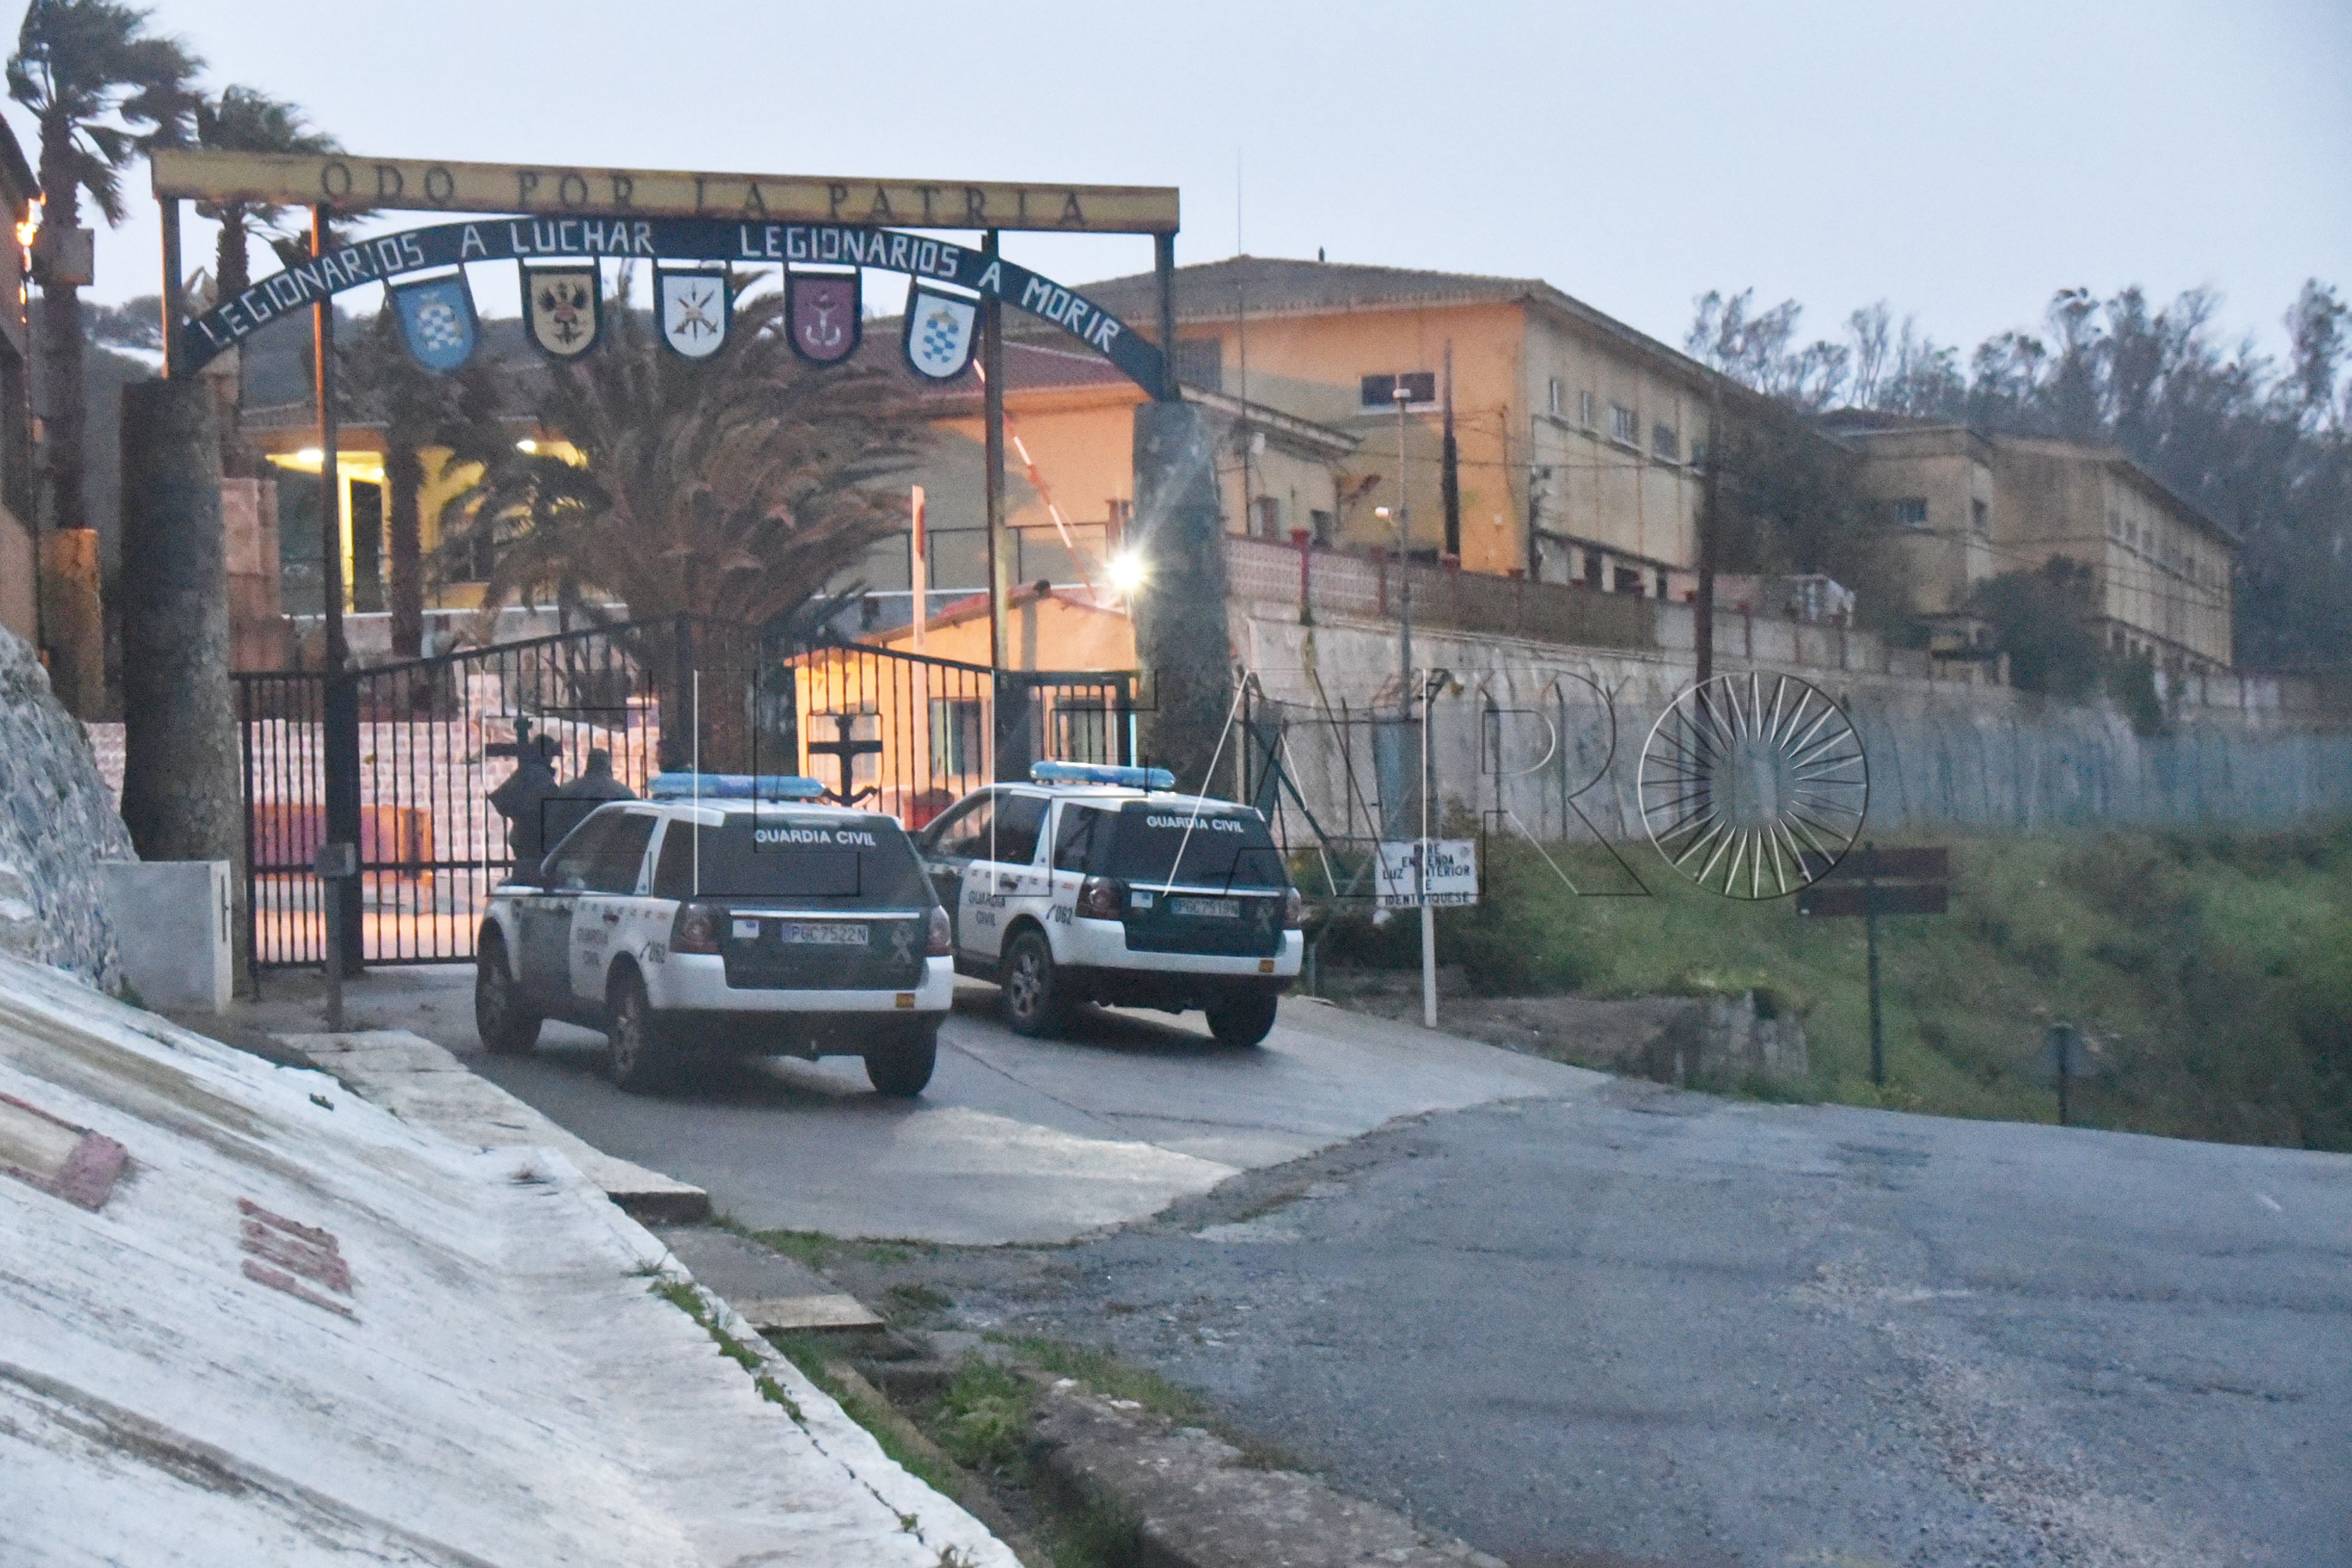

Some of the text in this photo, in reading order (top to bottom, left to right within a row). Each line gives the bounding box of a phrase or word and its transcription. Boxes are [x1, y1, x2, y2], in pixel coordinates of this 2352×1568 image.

[516, 169, 634, 212] POR
[827, 183, 1089, 226] PATRIA
[200, 220, 1120, 352] LEGIONARIOS A LUCHAR LEGIONARIOS A MORIR
[755, 829, 877, 846] GUARDIA CIVIL
[1147, 816, 1245, 833] GUARDIA CIVIL
